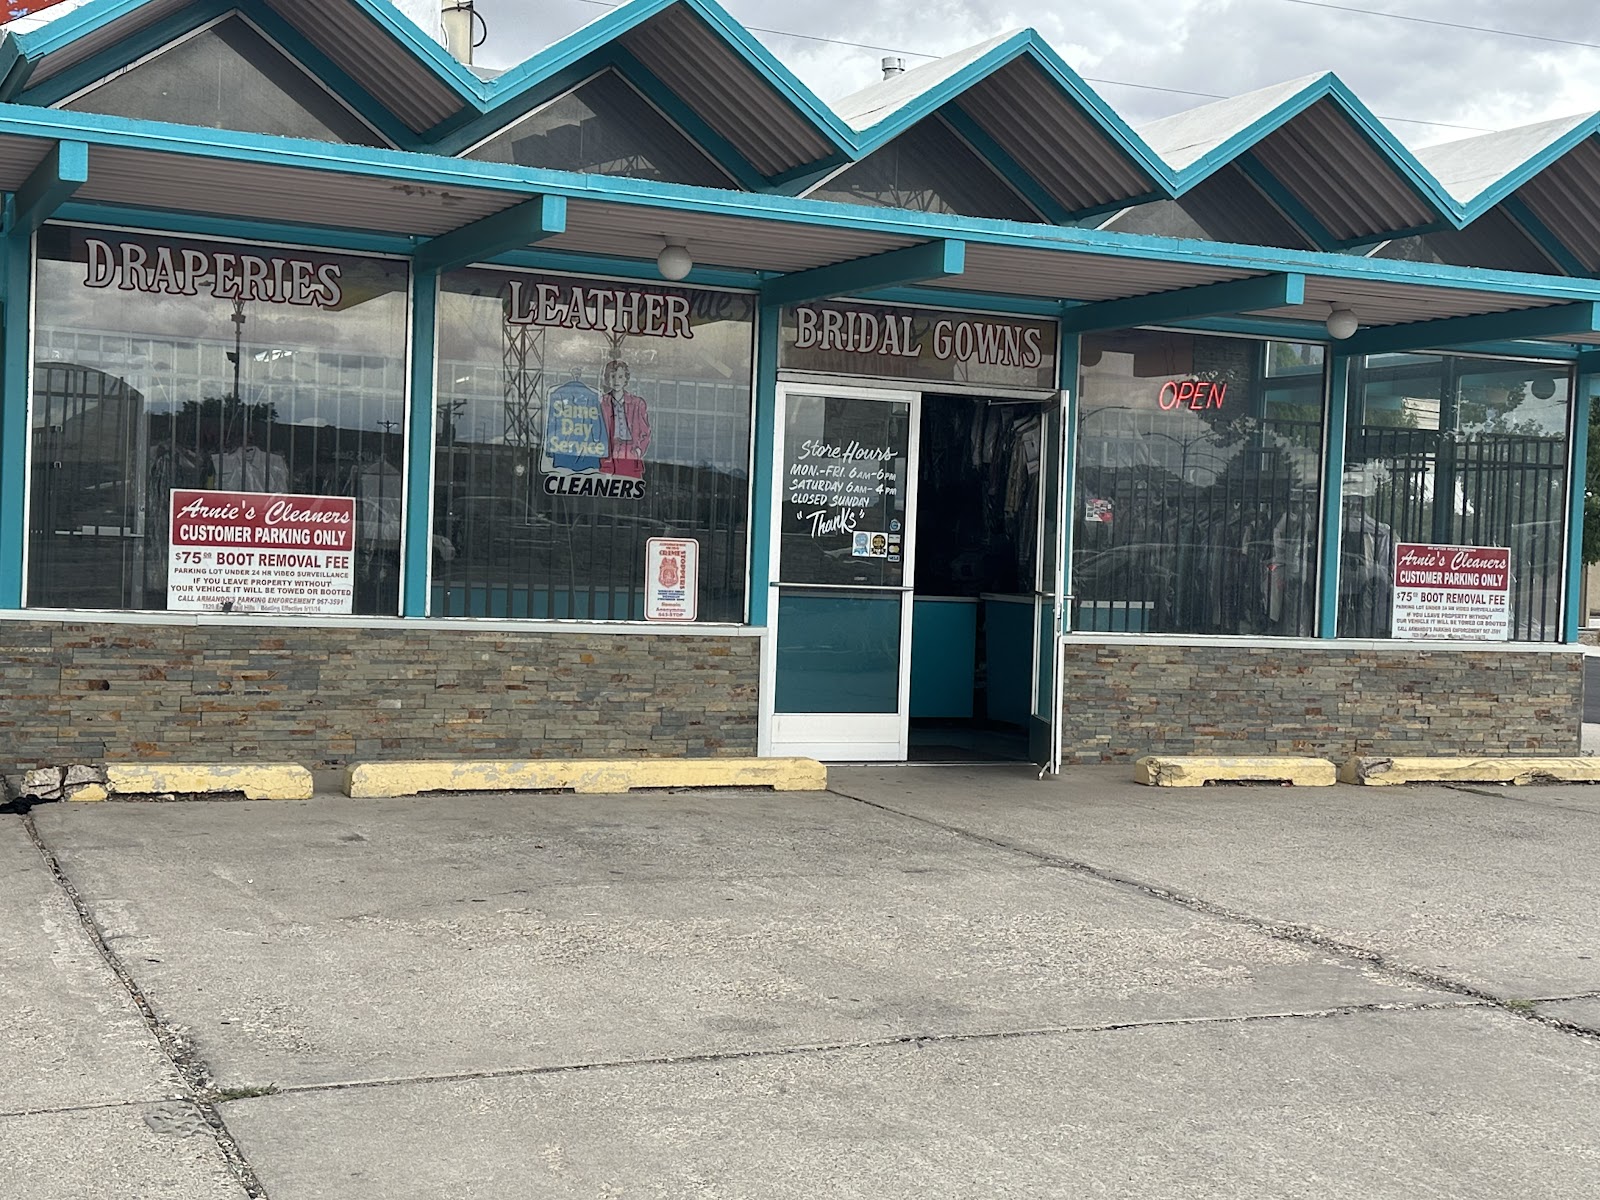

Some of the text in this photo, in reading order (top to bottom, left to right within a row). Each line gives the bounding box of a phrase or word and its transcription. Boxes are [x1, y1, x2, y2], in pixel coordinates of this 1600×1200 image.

[84, 238, 342, 308] DRAPERIES
[507, 280, 694, 339] LEATHER
[794, 307, 1042, 368] BRIDAL GOWNS
[1158, 380, 1227, 410] OPEN
[553, 400, 598, 420] Same
[561, 418, 594, 441] Day
[549, 436, 605, 456] Service
[798, 439, 898, 464] Store Hours
[544, 475, 646, 499] CLEANERS
[789, 479, 844, 493] SATURDAY
[791, 493, 870, 508] CLOSED SUNDAY
[177, 497, 350, 525] Arnie's Cleaners
[179, 524, 346, 546] CUSTOMER PARKING ONLY
[216, 552, 254, 566] BOOT
[258, 553, 321, 568] REMOVAL
[325, 556, 349, 569] FEE
[1398, 549, 1507, 571] Arnie's Cleaners
[174, 567, 207, 575] PARKING
[297, 571, 349, 579] SURVEILLANCE
[203, 577, 220, 585] YOU
[250, 579, 293, 587] PROPERTY
[294, 580, 331, 588] WITHOUT
[1400, 570, 1504, 587] CUSTOMER PARKING ONLY
[195, 585, 231, 593] VEHICLE
[243, 586, 263, 594] WILL
[277, 587, 305, 595] TOWED
[1420, 592, 1444, 603] BOOT
[1446, 593, 1486, 605] REMOVAL
[1488, 594, 1505, 606] FEE
[237, 596, 266, 604] PARKING
[267, 597, 316, 605] ENFORCEMENT
